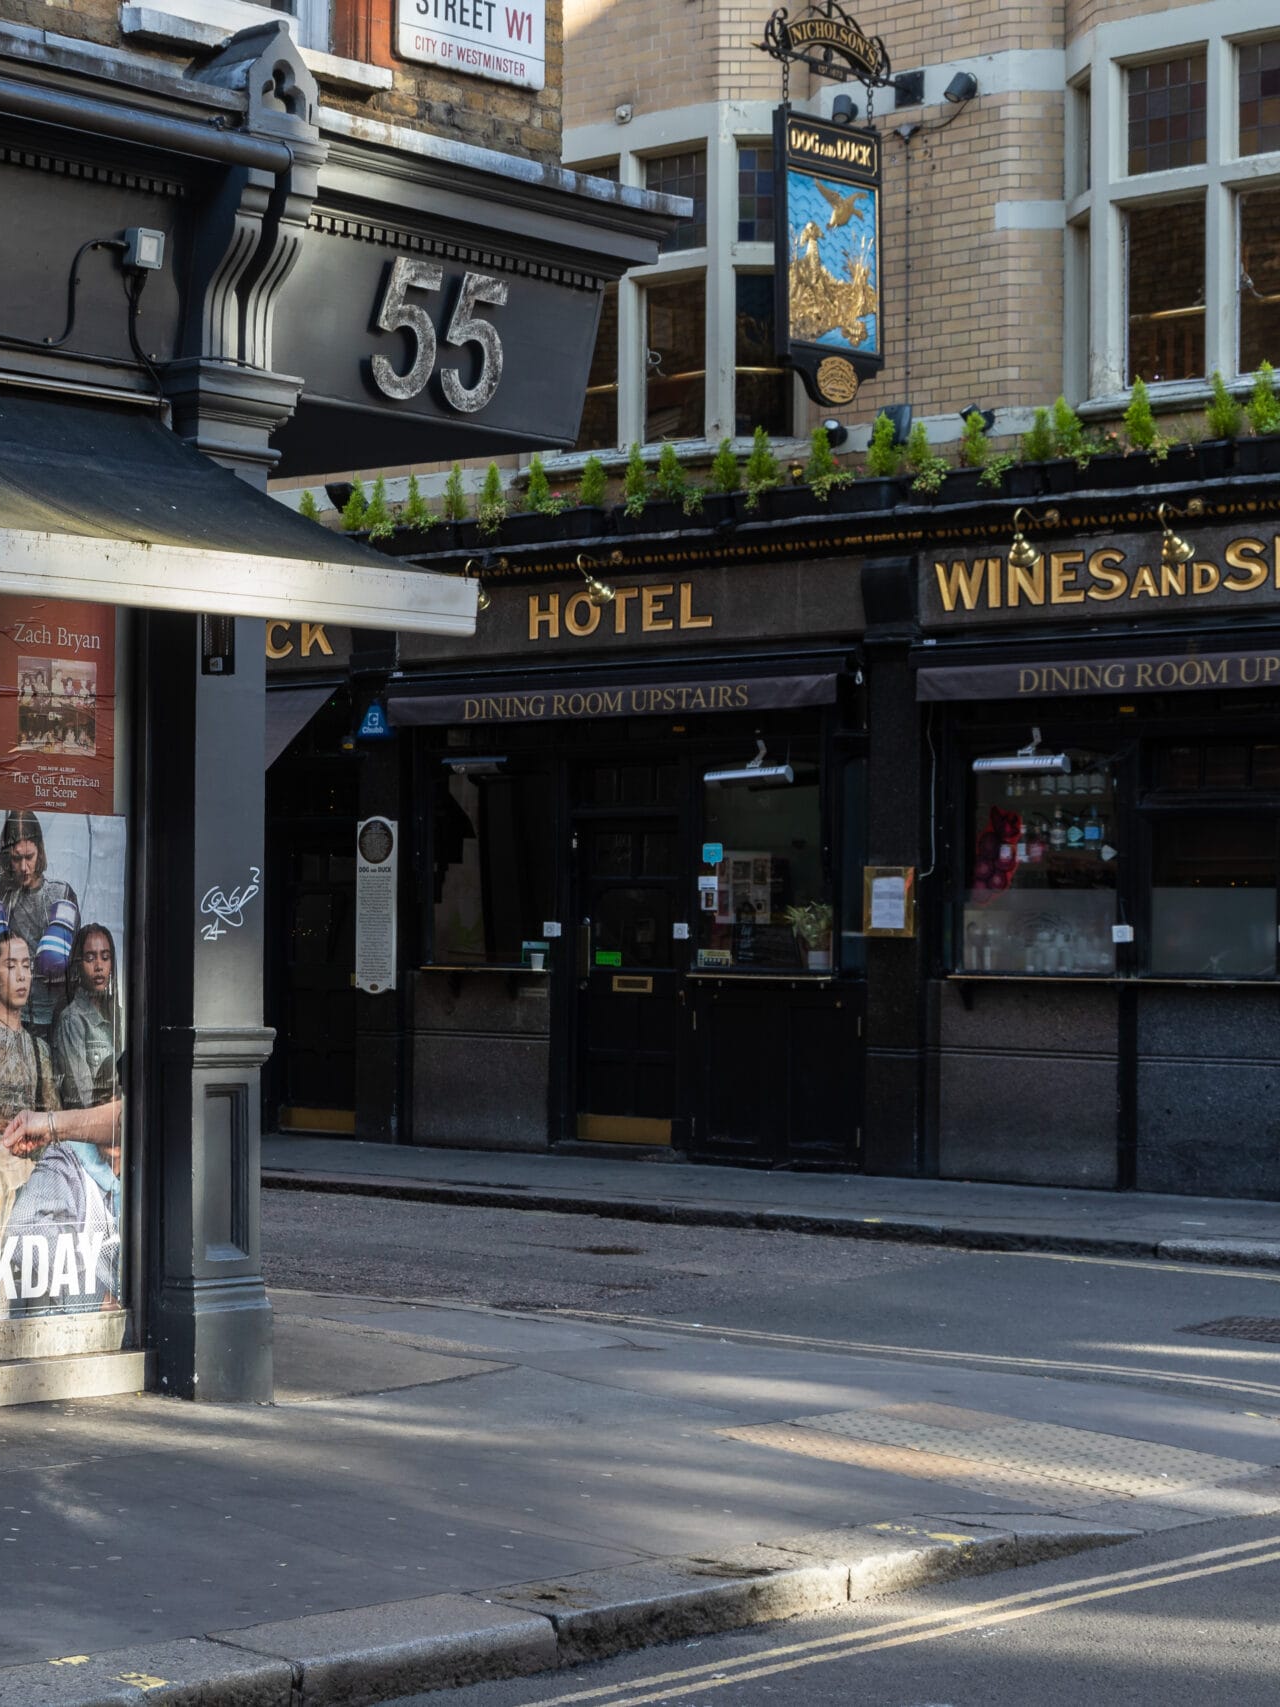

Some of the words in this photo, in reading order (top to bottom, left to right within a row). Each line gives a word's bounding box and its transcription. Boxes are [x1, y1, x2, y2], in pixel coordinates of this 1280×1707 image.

[505, 6, 532, 44] W1
[791, 22, 876, 66] NICHOLSON'S
[415, 35, 437, 55] CITY
[440, 42, 454, 58] OF
[456, 45, 525, 78] WESTMINSTER
[790, 128, 820, 154] DOG
[836, 138, 872, 168] DUCK
[371, 255, 510, 413] 55
[934, 548, 1130, 613] WINES
[1129, 559, 1221, 600] AND
[527, 581, 714, 642] HOTEL
[14, 623, 52, 645] Zach
[57, 627, 102, 654] Bryan
[1019, 663, 1126, 693] DINING
[1134, 659, 1230, 688] ROOM
[463, 694, 551, 723] DINING
[558, 688, 625, 717] ROOM
[631, 682, 750, 713] UPSTAIRS
[13, 772, 30, 785] The
[32, 773, 56, 786] Great
[58, 776, 100, 789] American
[34, 785, 52, 798] Bar
[53, 787, 78, 800] Scene
